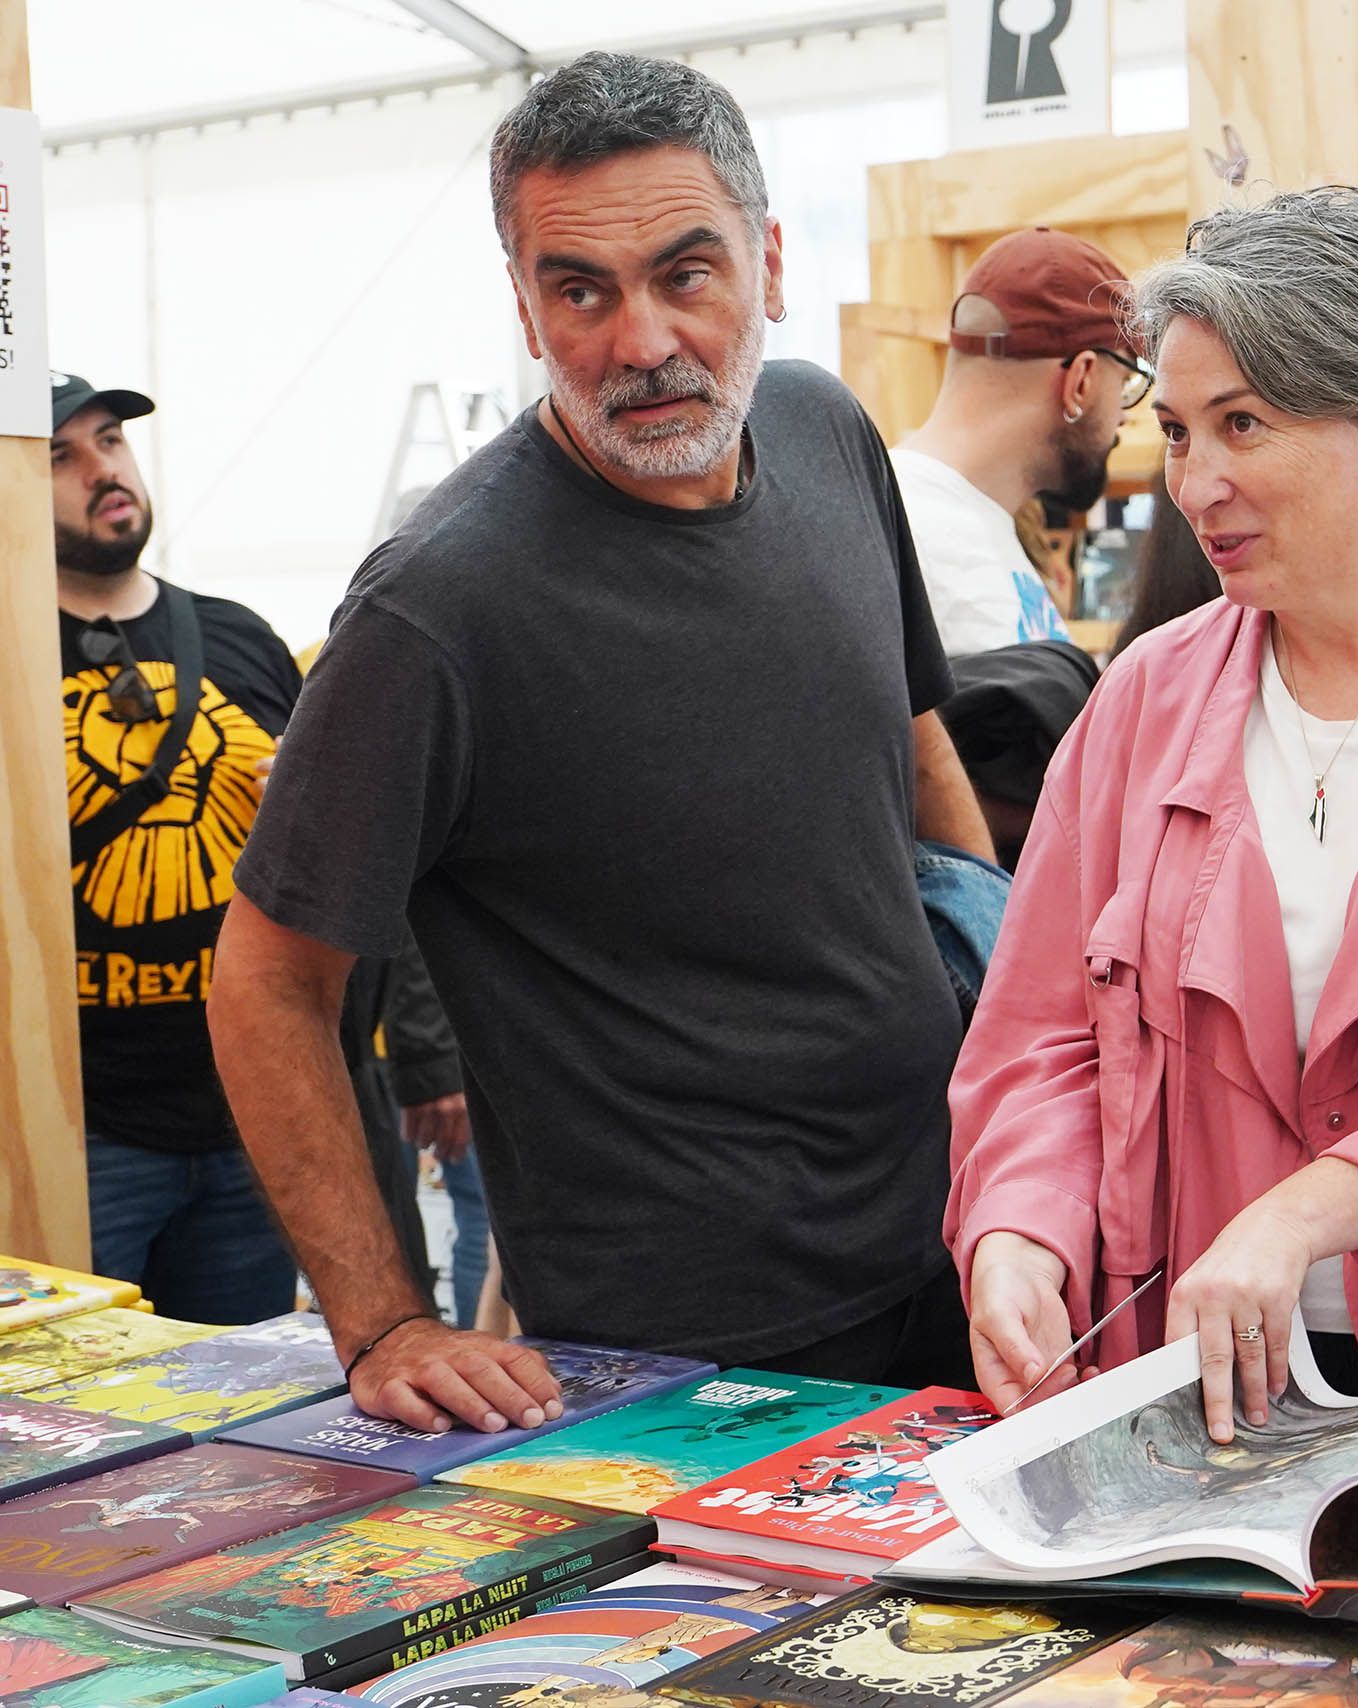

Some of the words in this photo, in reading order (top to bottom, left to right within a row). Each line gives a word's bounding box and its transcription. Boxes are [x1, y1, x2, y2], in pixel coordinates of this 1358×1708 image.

[452, 1498, 533, 1520] NUIT
[535, 1514, 577, 1531] LA
[391, 1510, 527, 1544] LAPA
[403, 1603, 457, 1637] LAPA
[461, 1593, 484, 1614] LA
[392, 1635, 448, 1669] LAPA
[452, 1625, 475, 1646] LA
